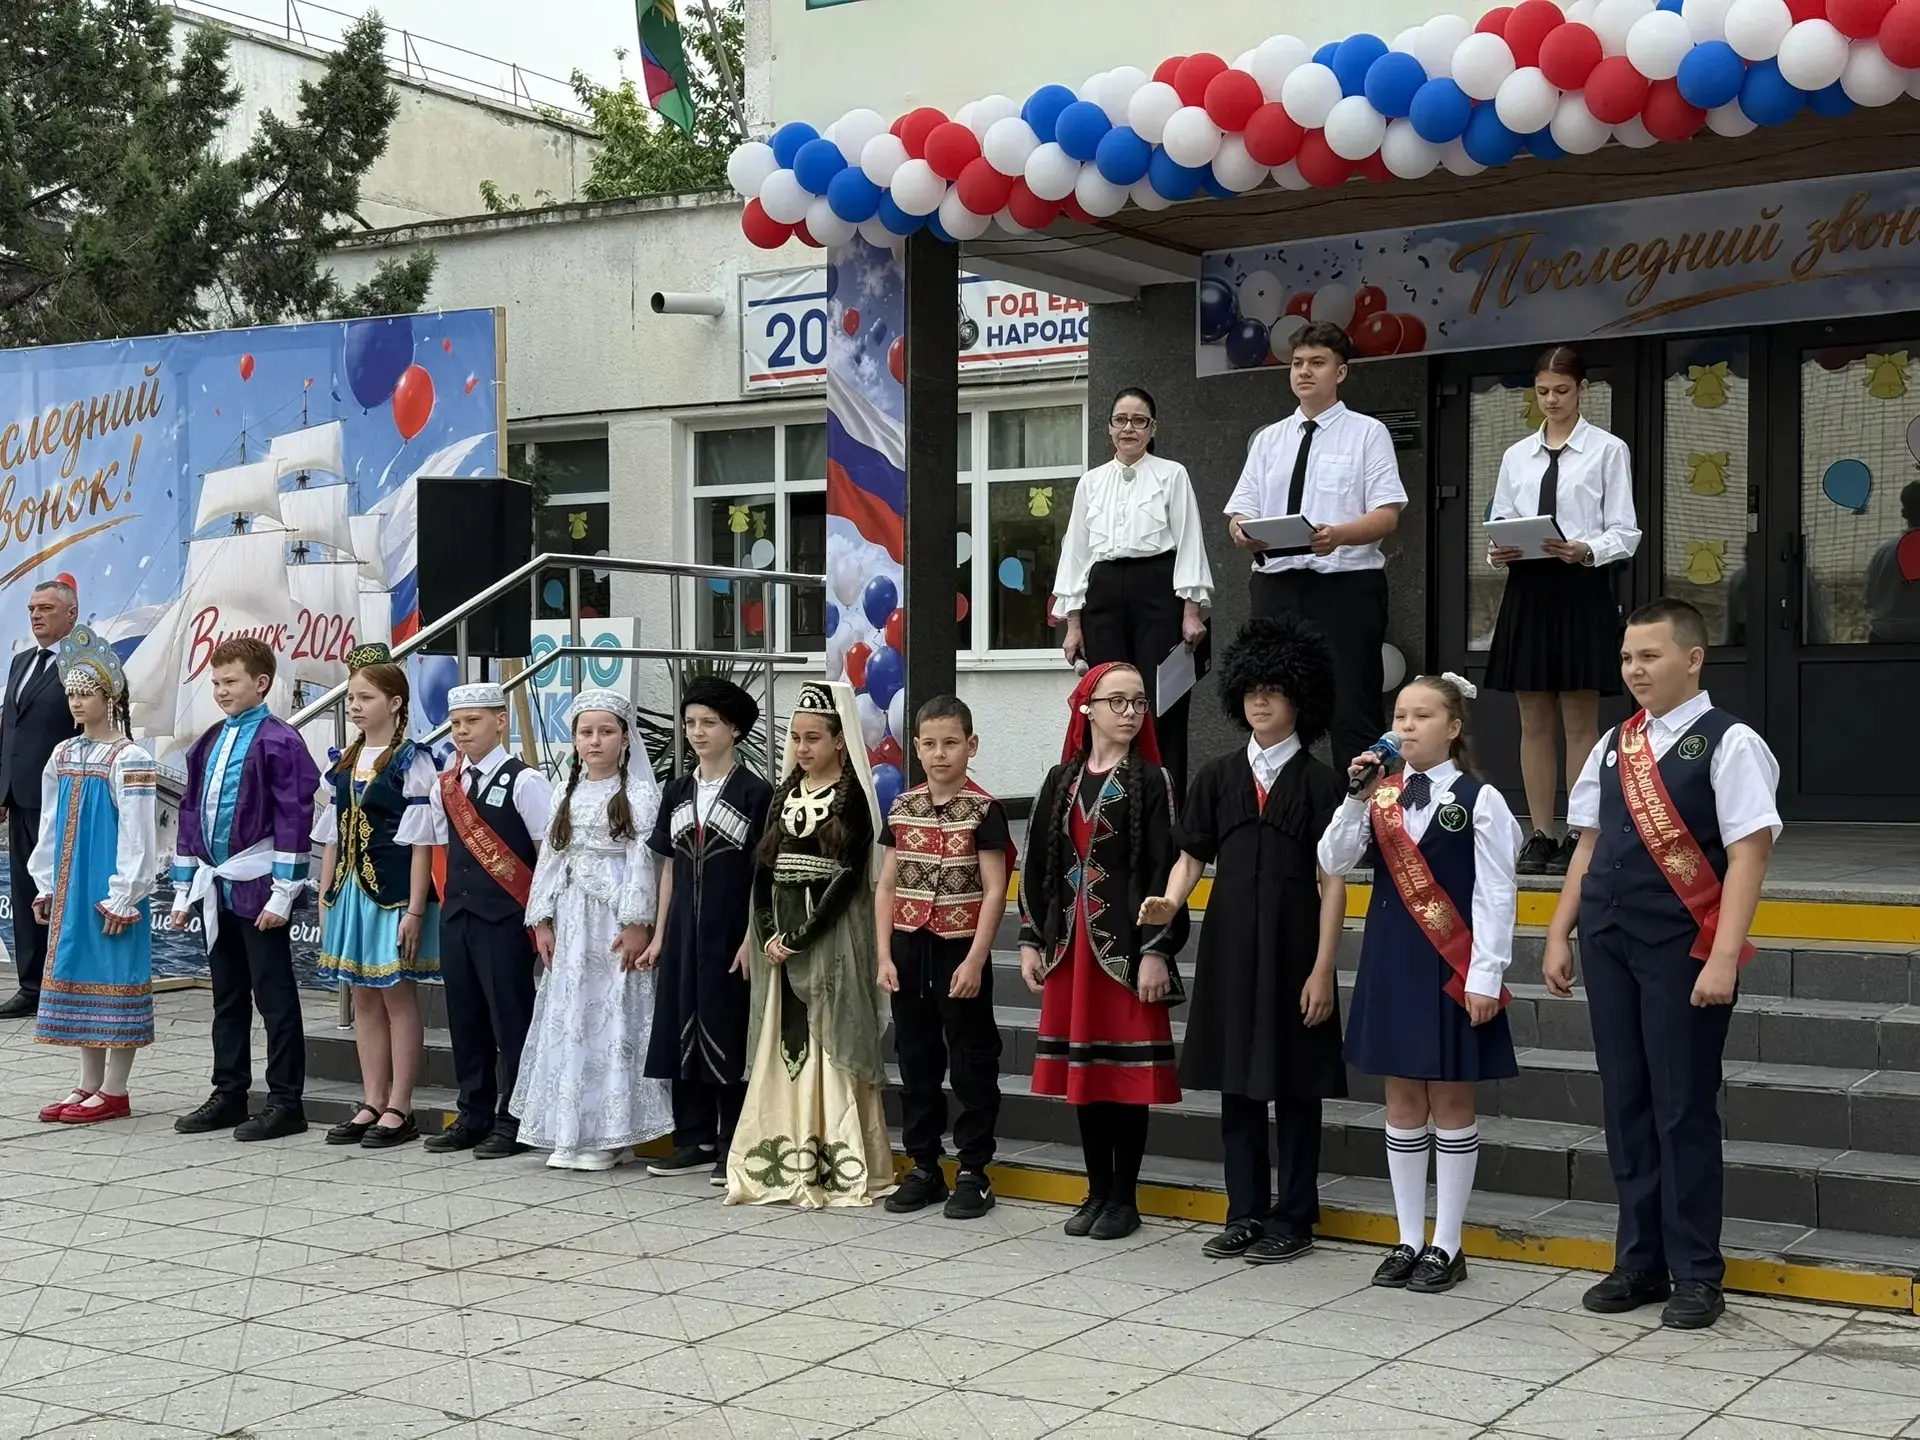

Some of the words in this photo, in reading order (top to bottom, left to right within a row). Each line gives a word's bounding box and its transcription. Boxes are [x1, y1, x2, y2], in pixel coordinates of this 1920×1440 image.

[1448, 204, 1783, 315] Последний
[1791, 190, 1920, 276] звон
[765, 307, 827, 369] 20
[986, 291, 1037, 318] ГОД
[1048, 293, 1089, 313] ЕД
[1629, 754, 1681, 842] Выпускник
